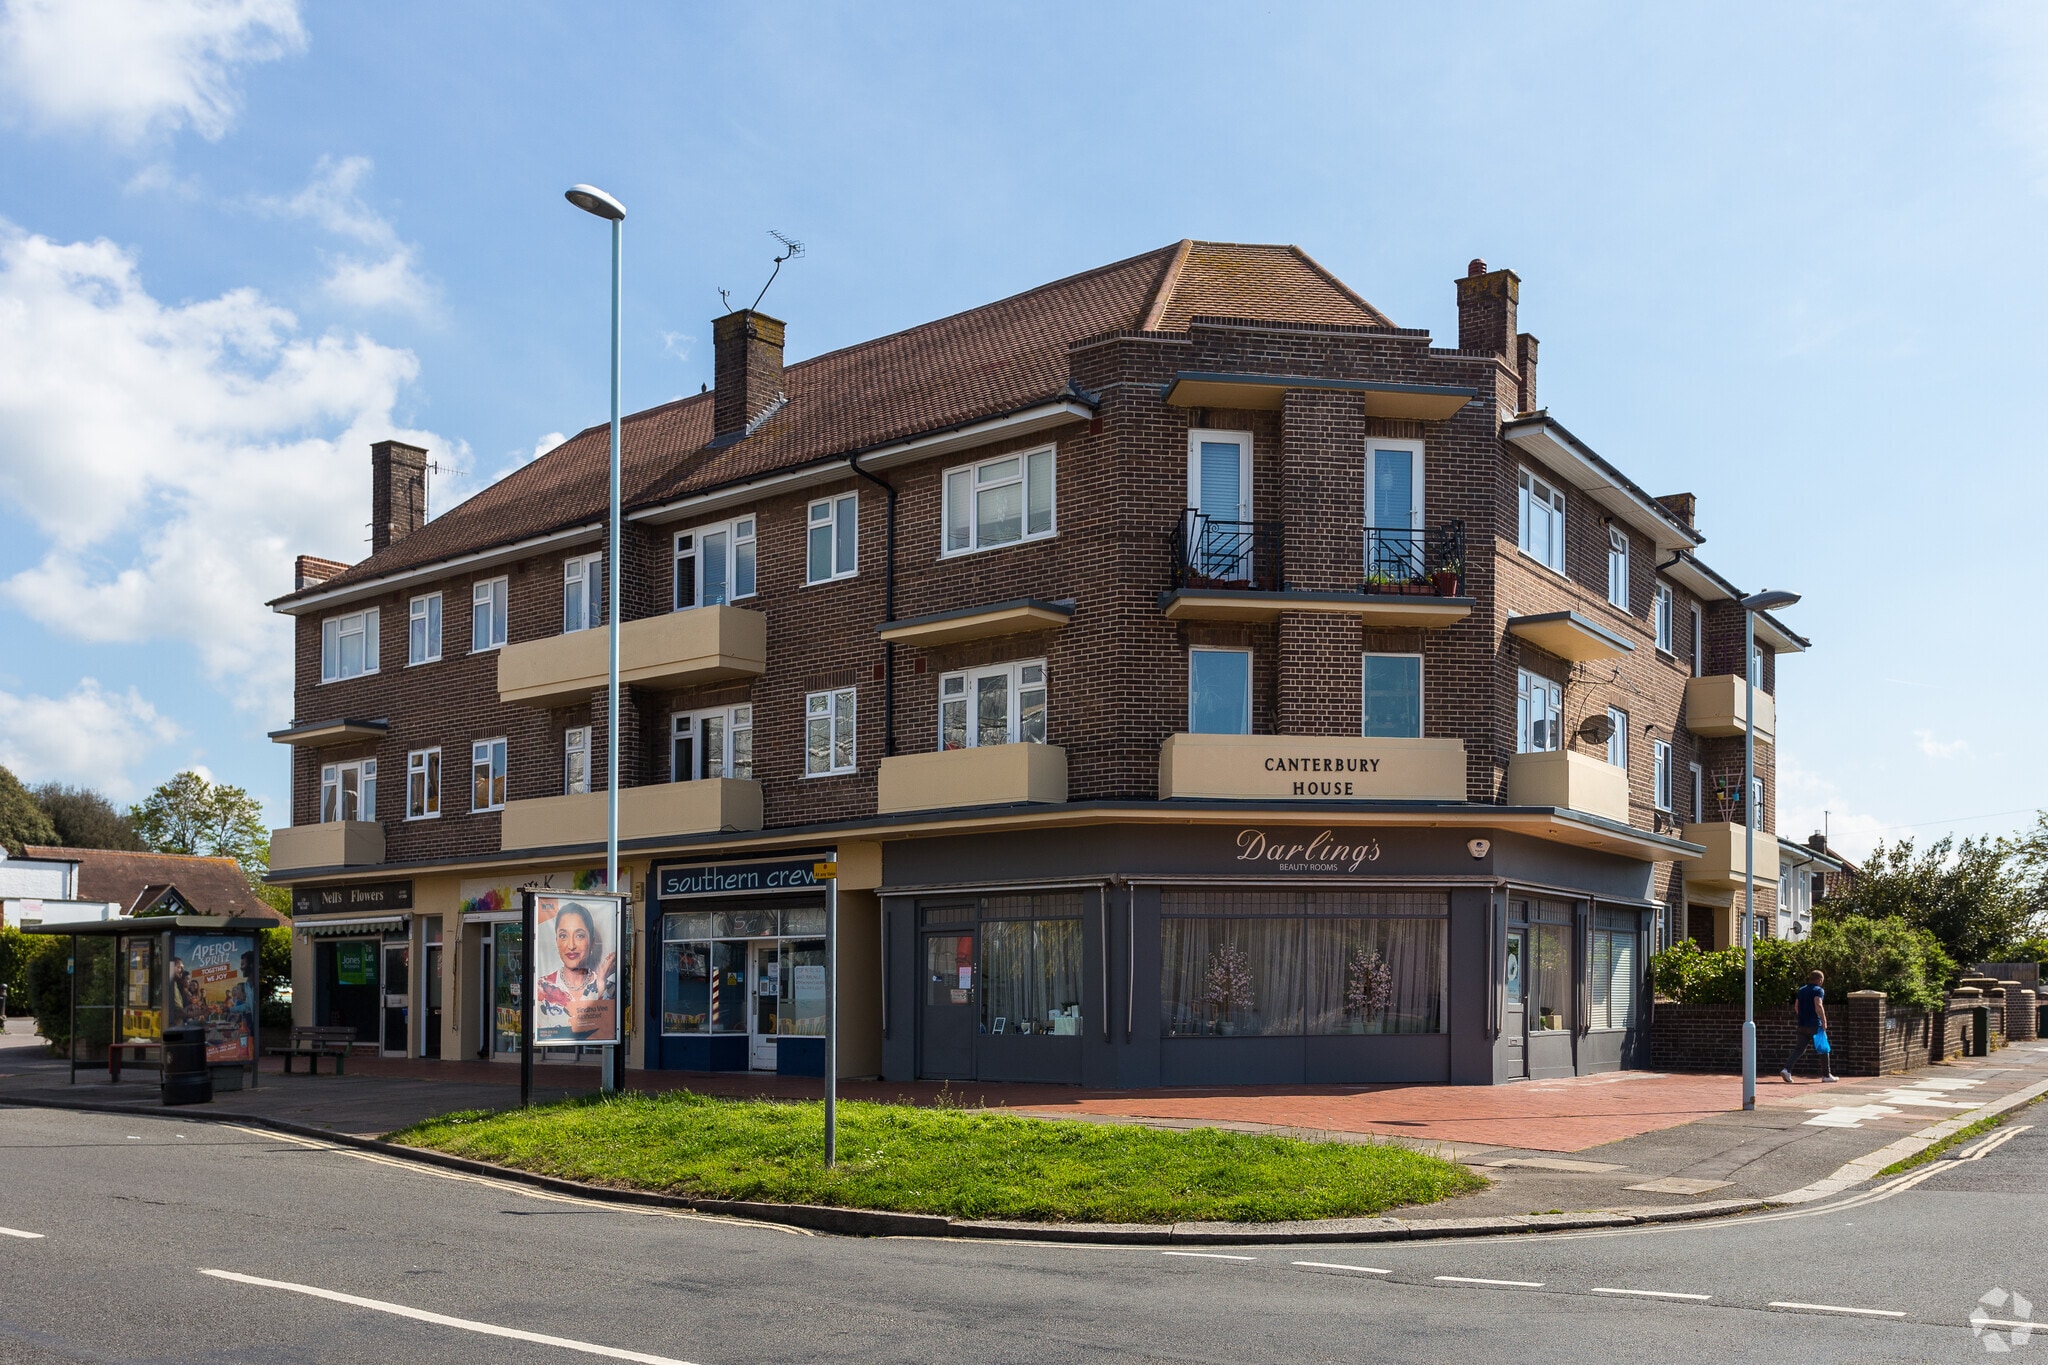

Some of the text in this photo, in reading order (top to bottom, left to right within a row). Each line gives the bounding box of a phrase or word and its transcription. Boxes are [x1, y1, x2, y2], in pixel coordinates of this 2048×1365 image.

[1264, 757, 1380, 772] CANTERBURY
[1293, 782, 1354, 796] HOUSE
[1236, 829, 1380, 872] Darling's
[1279, 863, 1338, 871] BEAUTY ROOMS
[666, 866, 818, 893] southern crew
[321, 891, 342, 905] Nell's
[351, 889, 384, 903] Flowers
[192, 940, 238, 960] APEROL
[200, 952, 230, 967] SPRITZ
[341, 955, 360, 964] Jones
[201, 964, 228, 975] TOGETHER
[215, 973, 228, 981] JOY
